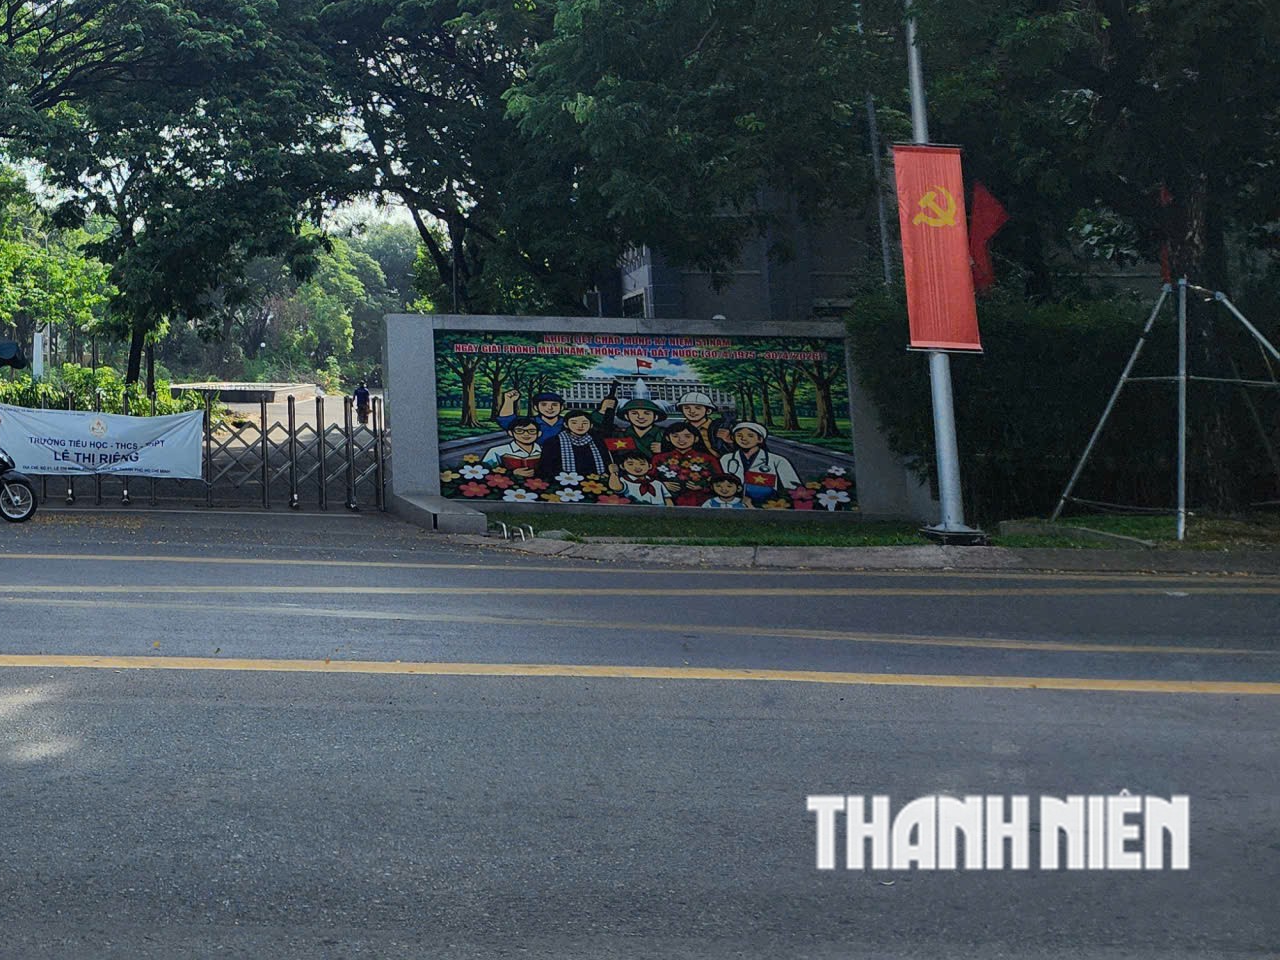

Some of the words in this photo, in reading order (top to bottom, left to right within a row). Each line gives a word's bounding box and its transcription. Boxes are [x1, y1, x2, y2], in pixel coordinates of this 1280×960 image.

[29, 436, 66, 448] TRƯỜNG
[68, 438, 87, 448] TIỂU
[89, 441, 108, 451] HỌC
[115, 442, 138, 450] THCS
[54, 449, 70, 461] LÊ
[74, 452, 96, 466] THỊ
[99, 451, 139, 464] RIÊNG
